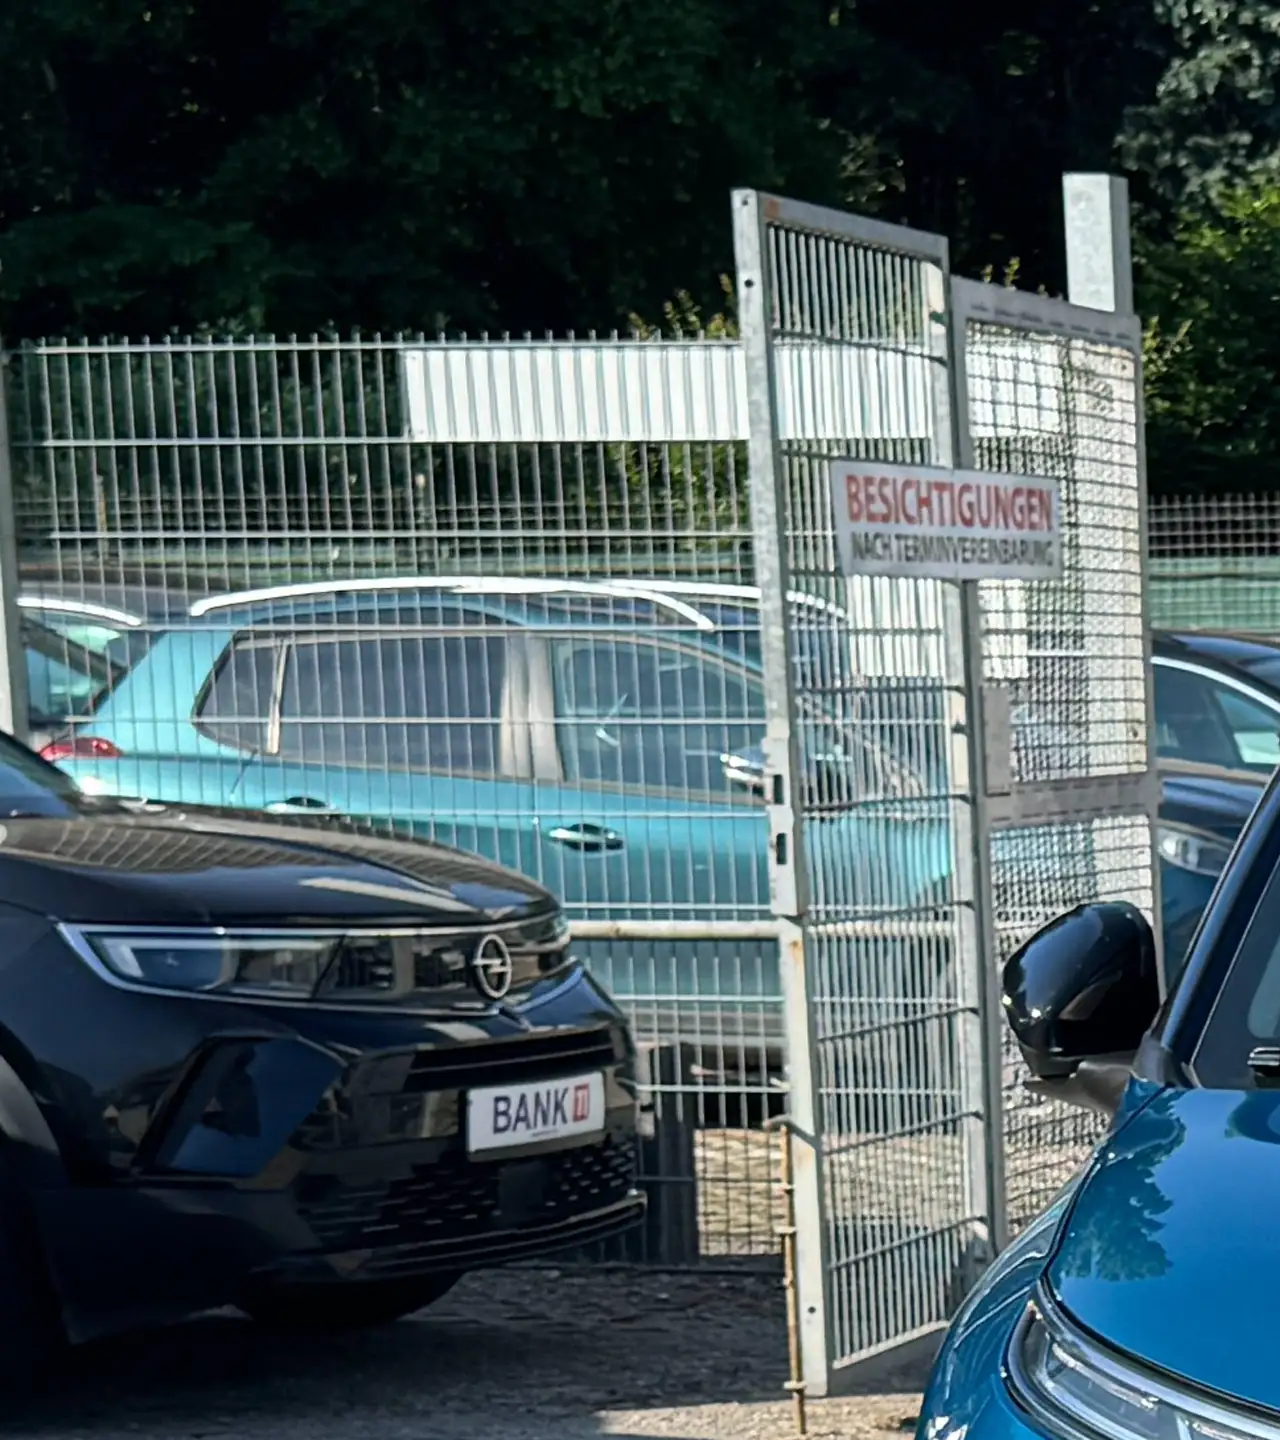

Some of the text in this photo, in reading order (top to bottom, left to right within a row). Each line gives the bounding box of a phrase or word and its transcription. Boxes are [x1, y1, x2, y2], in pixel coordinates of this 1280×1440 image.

[845, 474, 1054, 532] BESICHTIGUNGEN
[851, 531, 892, 561] NACH
[492, 1087, 569, 1134] BANK
